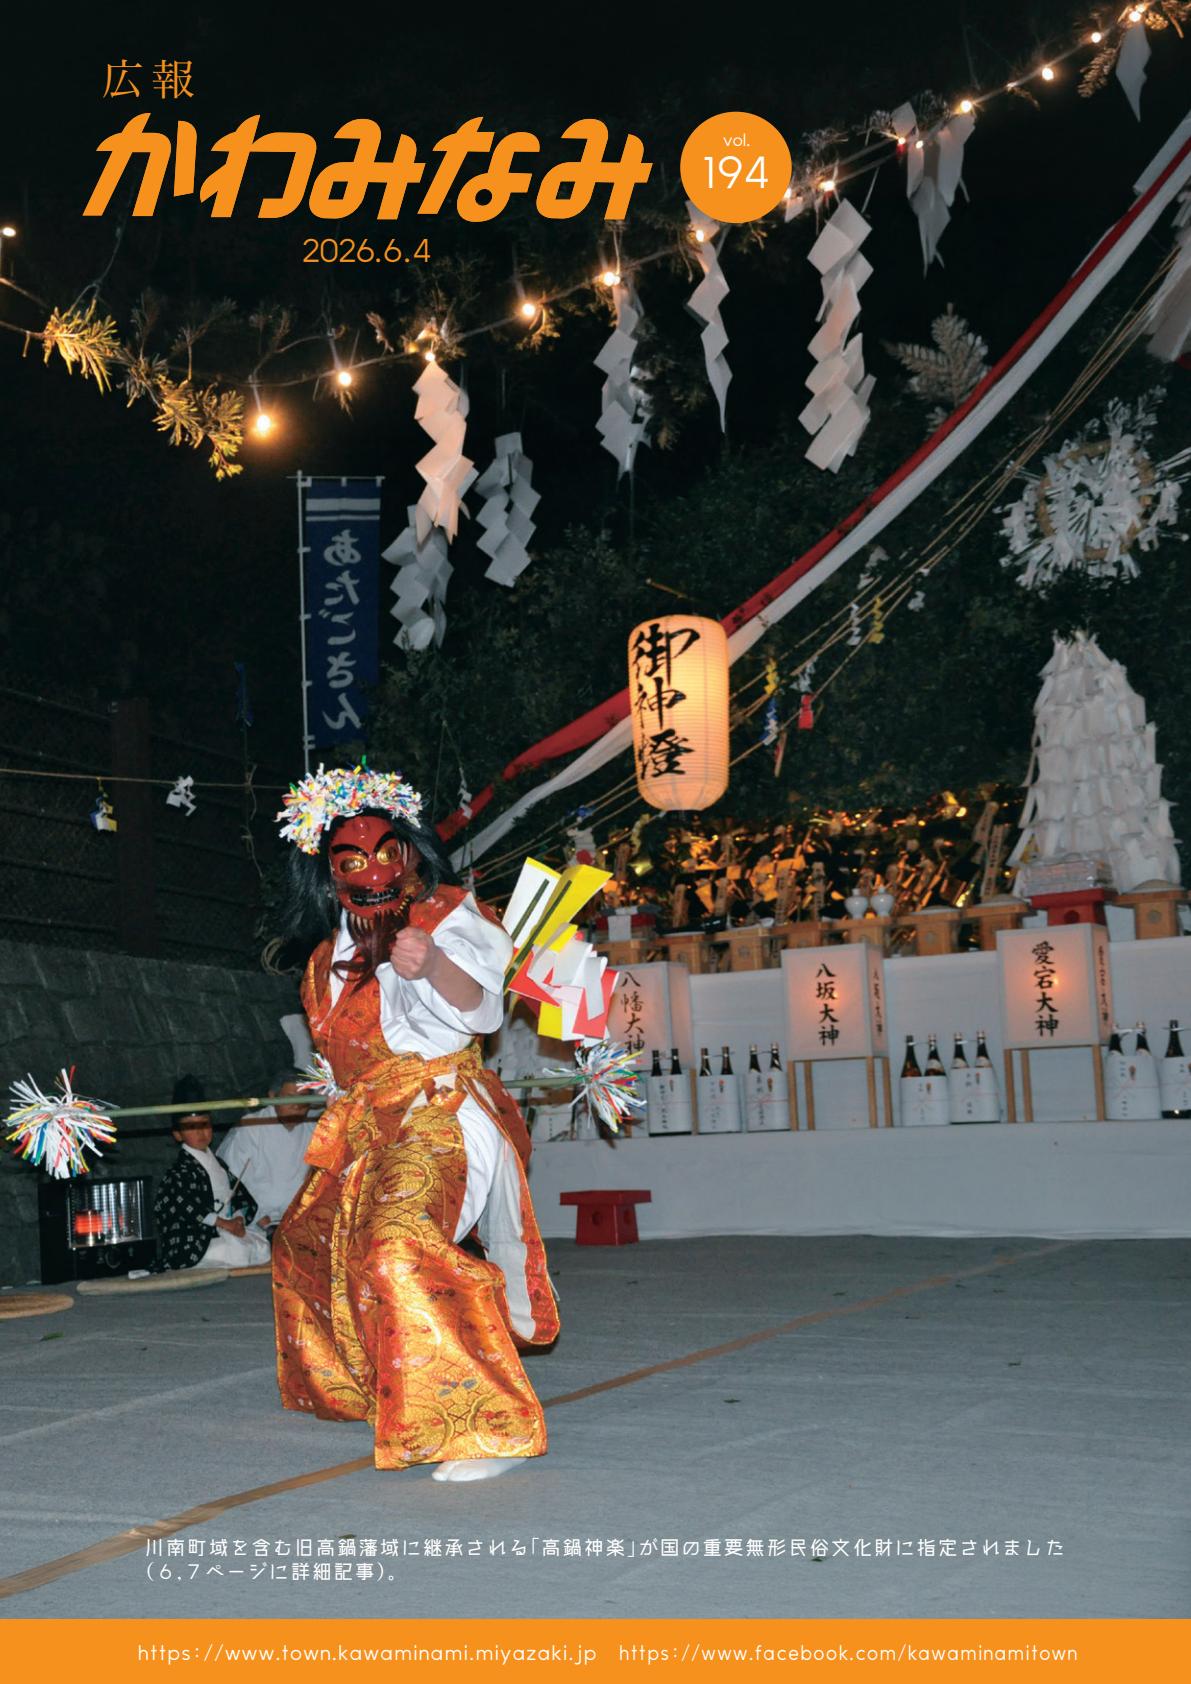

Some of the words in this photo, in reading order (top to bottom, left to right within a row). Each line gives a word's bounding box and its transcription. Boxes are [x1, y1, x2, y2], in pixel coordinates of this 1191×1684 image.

[620, 970, 646, 1056] 八幡大神
[815, 962, 841, 1047] 八坂大神
[1031, 940, 1060, 1037] 愛宕大神
